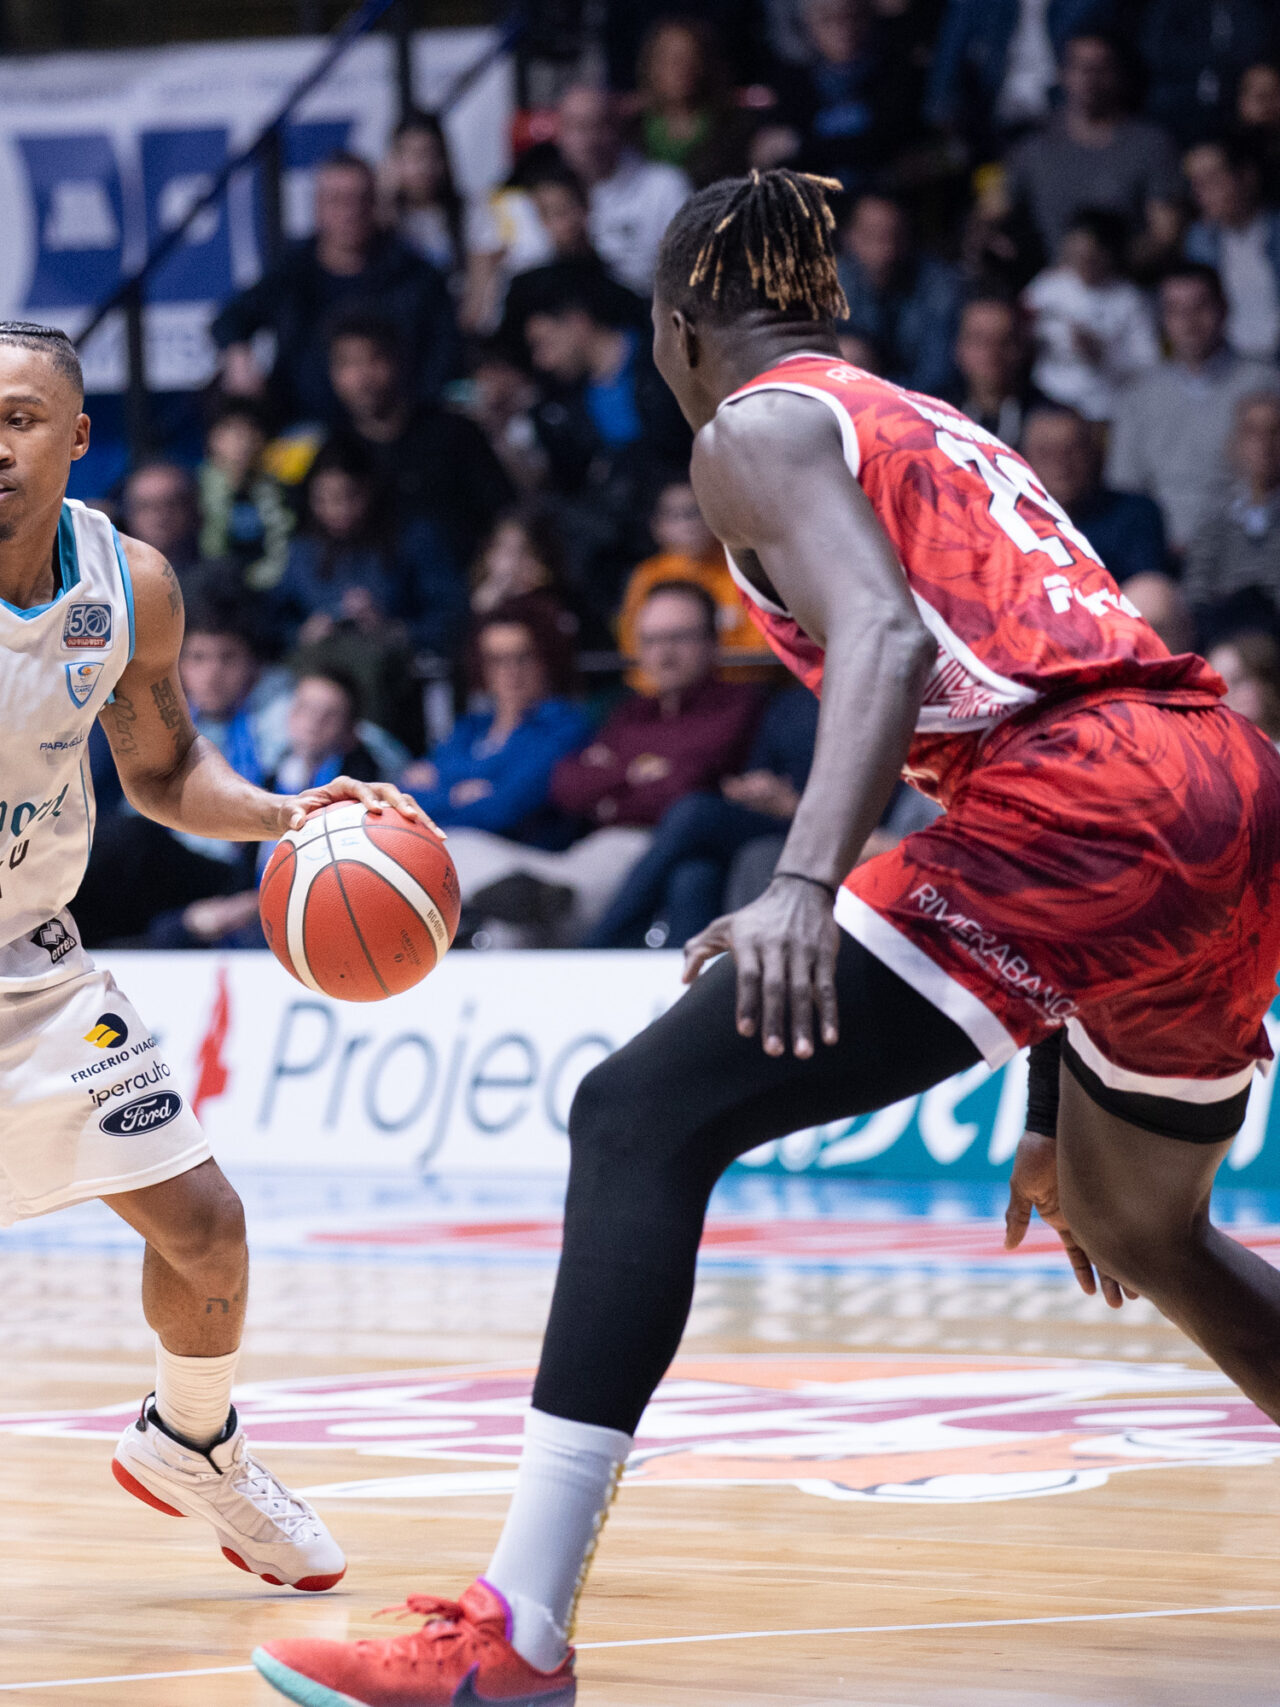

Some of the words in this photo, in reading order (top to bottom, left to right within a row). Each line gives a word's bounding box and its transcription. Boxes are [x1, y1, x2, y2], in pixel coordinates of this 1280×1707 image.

[908, 882, 1080, 1020] RIVIERABANC
[70, 1050, 131, 1083] FRIGERIO
[88, 1060, 171, 1108] iperauto
[256, 998, 677, 1170] Projec
[120, 1097, 173, 1132] Ford
